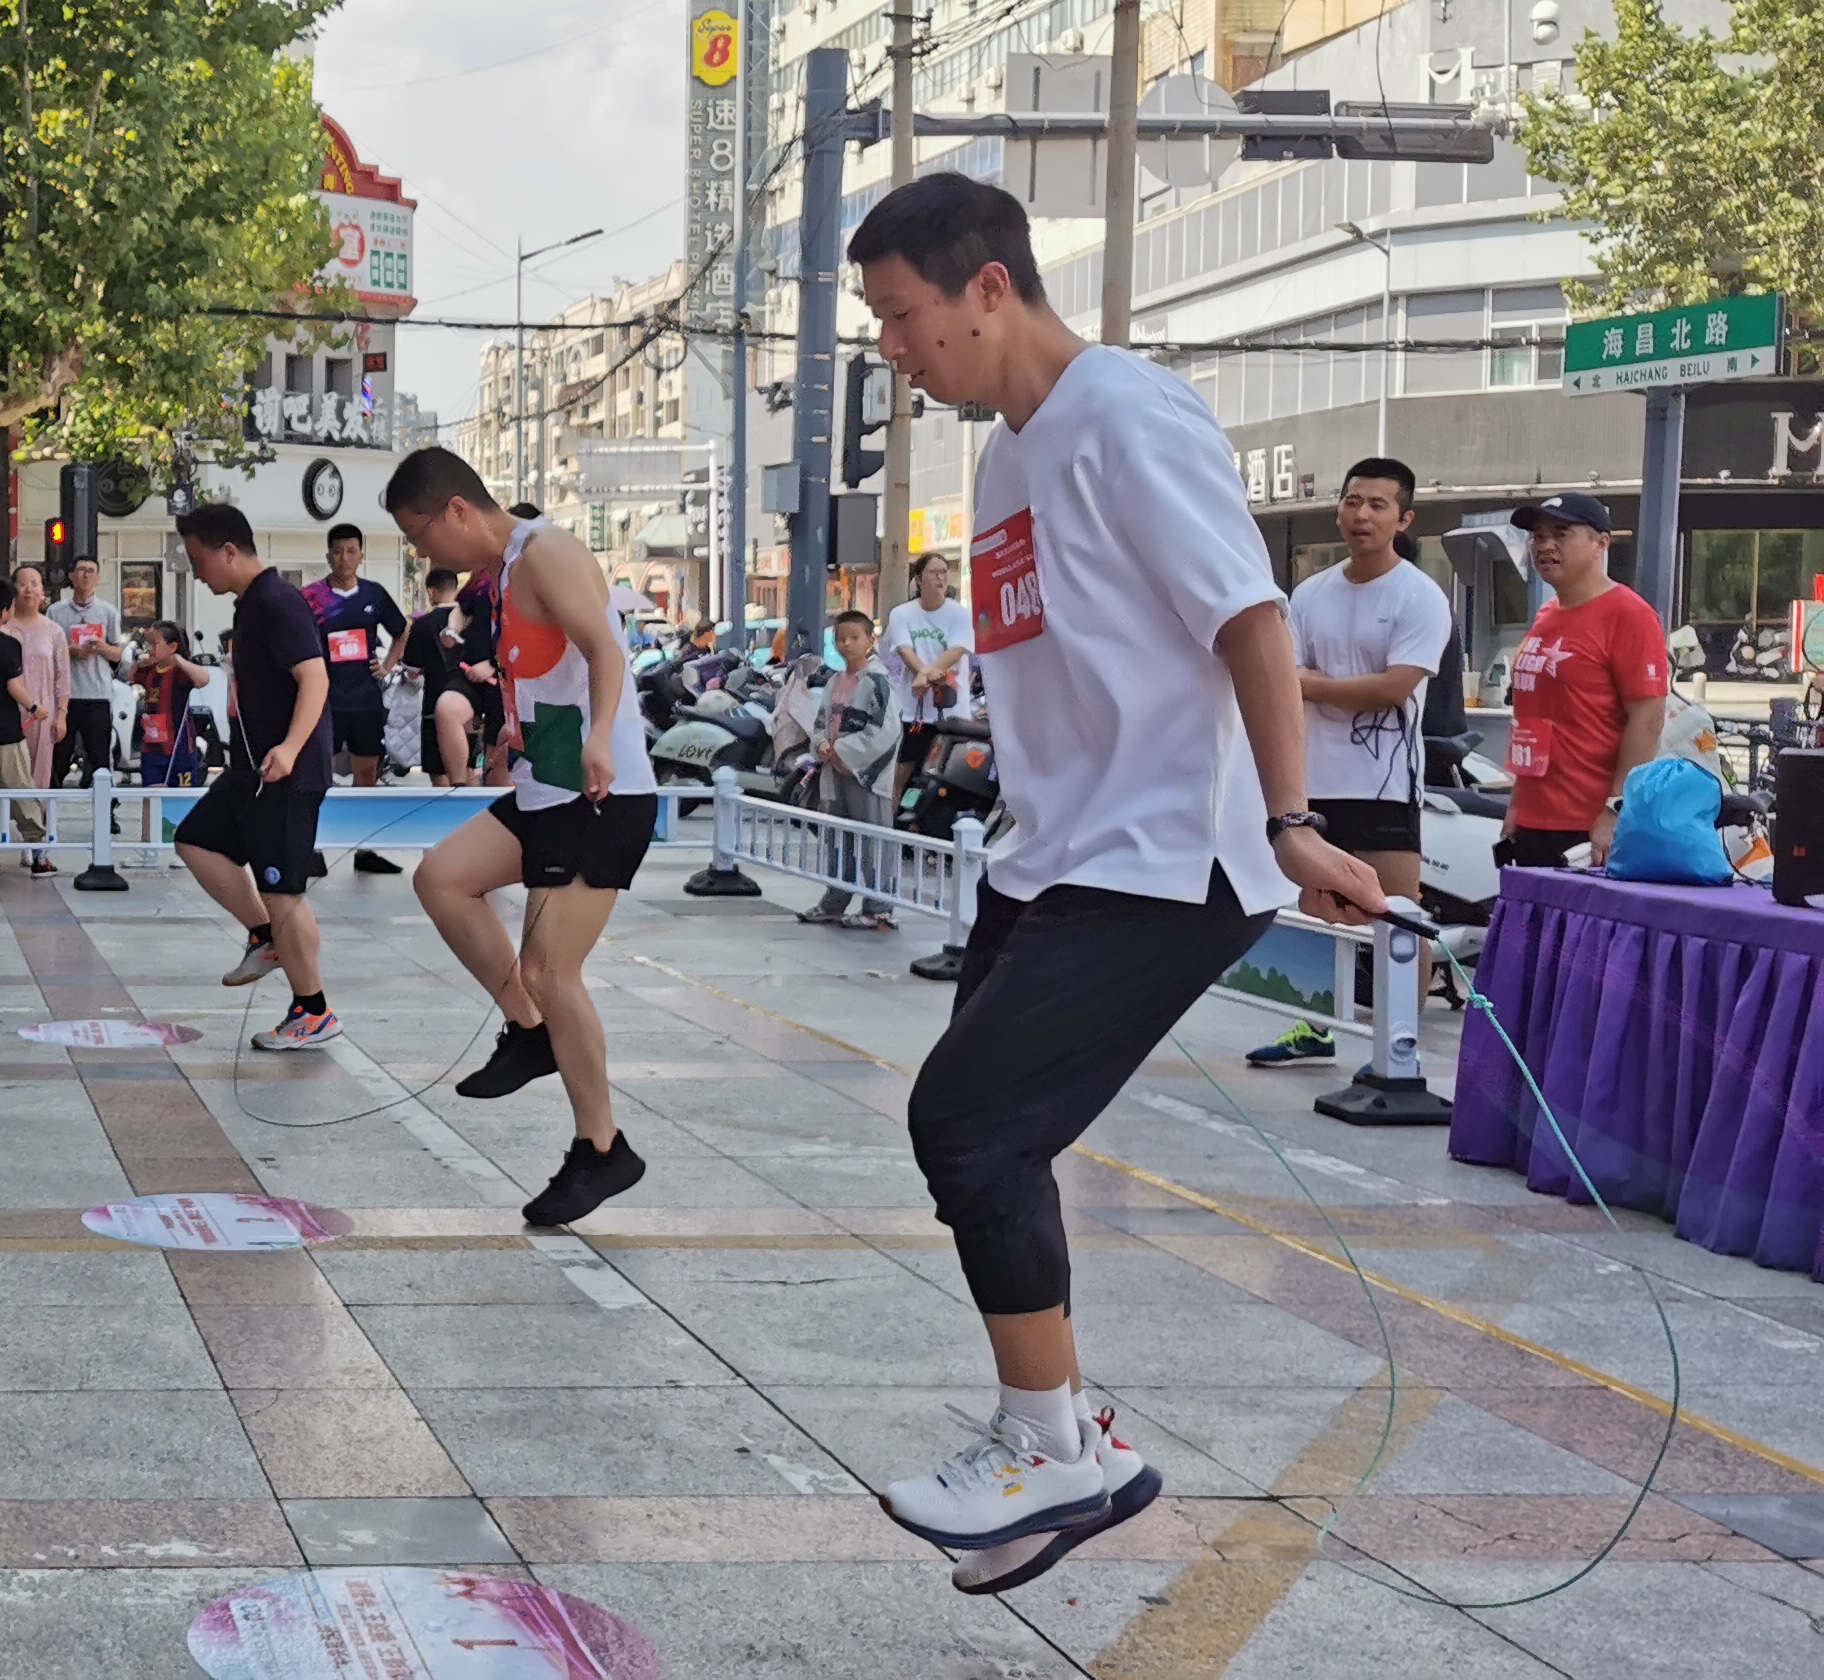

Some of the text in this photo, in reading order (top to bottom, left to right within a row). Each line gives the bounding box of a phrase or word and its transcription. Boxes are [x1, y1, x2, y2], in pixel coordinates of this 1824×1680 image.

[703, 33, 732, 68] 8
[689, 98, 703, 160] SUPER
[1601, 310, 1729, 361] 海昌北路
[1616, 361, 1710, 386] HAICHANG BEILU
[1727, 356, 1738, 373] 南
[1591, 373, 1602, 389] 北
[1233, 444, 1294, 501] 酒店
[177, 771, 193, 787] 12
